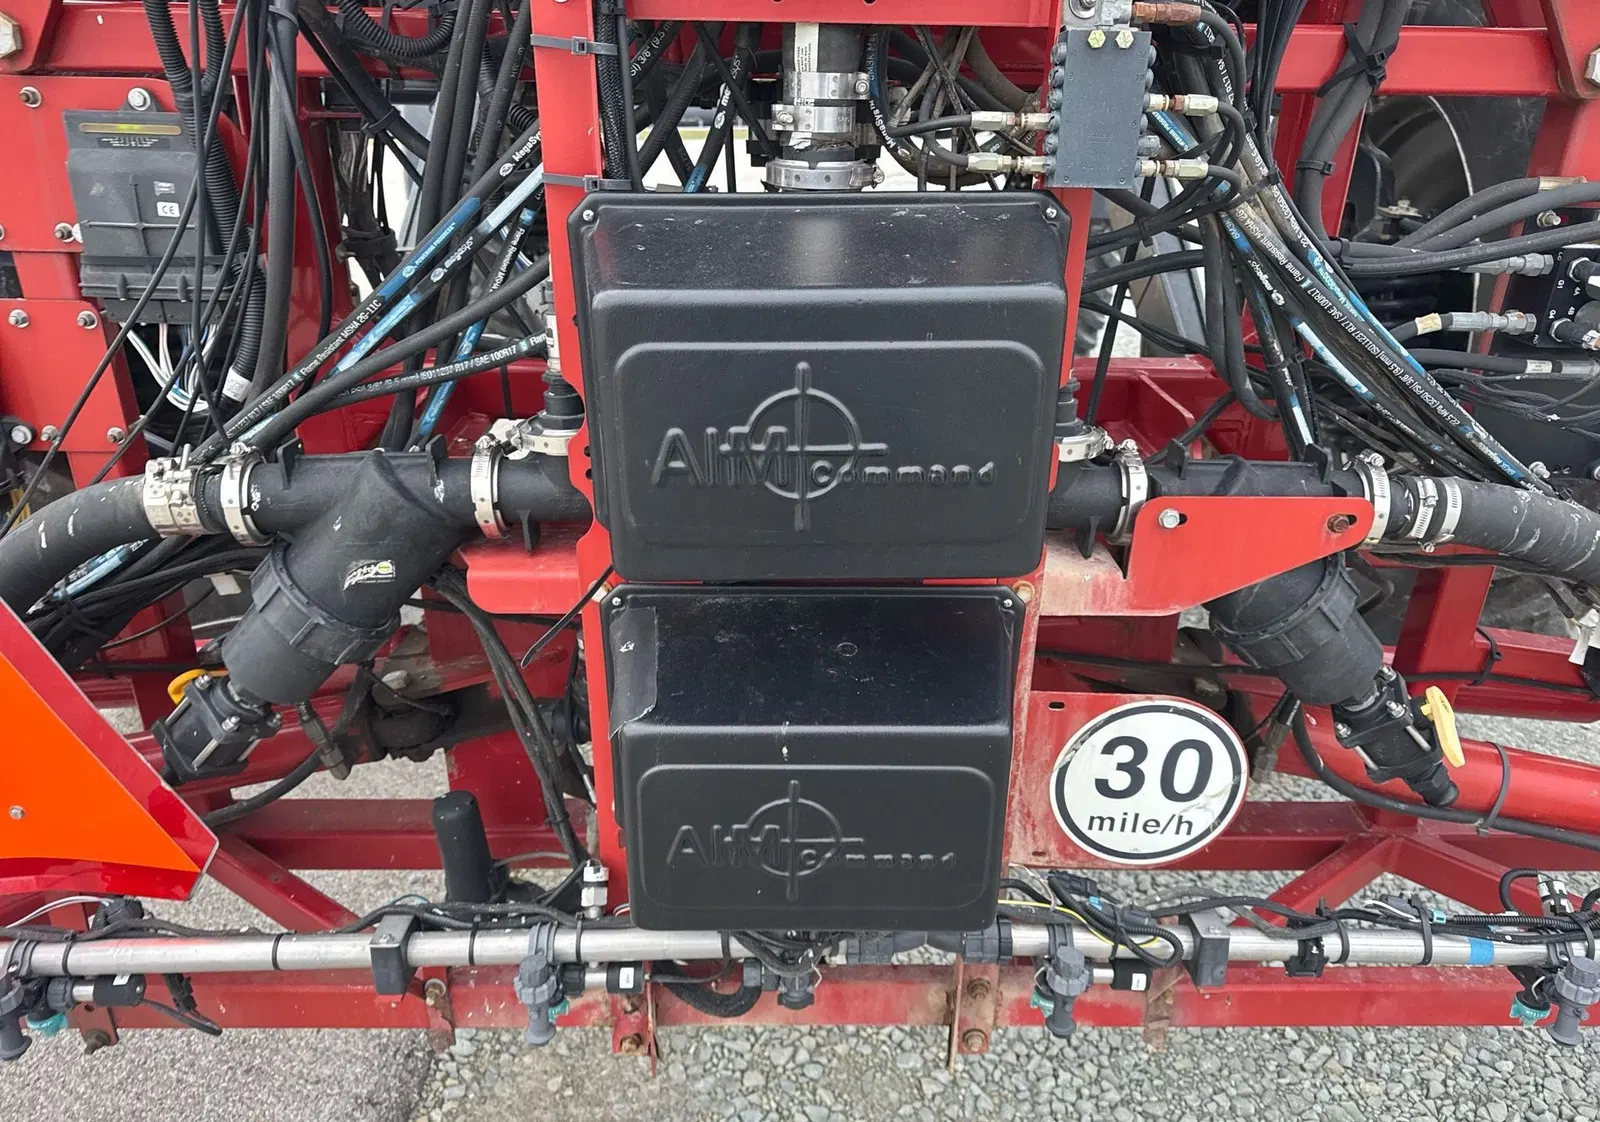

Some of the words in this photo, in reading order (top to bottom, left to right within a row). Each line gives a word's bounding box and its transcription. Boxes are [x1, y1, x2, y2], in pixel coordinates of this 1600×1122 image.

[648, 29, 668, 49] (9.5
[510, 226, 525, 247] Flame
[1243, 218, 1264, 239] MSHA
[498, 244, 517, 272] Resistant
[1259, 235, 1288, 265] Resistant
[490, 270, 505, 290] MSHA
[1283, 261, 1304, 282] Flame
[1306, 285, 1333, 310] 100R17
[1326, 304, 1343, 321] SAE
[1340, 318, 1357, 334] R17
[299, 356, 320, 377] Flame
[315, 334, 346, 362] Resistant
[340, 319, 361, 340] MSHA
[354, 297, 383, 324] 2G-11C
[1350, 327, 1381, 356] ISO11237
[454, 360, 469, 372] R17
[473, 353, 490, 367] SAE
[489, 344, 517, 361] 100R17
[1387, 360, 1404, 377] (9.5
[1419, 388, 1440, 409] (3250
[1433, 402, 1449, 418] MPa
[1444, 412, 1460, 428] 22.5
[650, 426, 791, 487] AIM
[809, 459, 997, 487] command
[1094, 735, 1214, 803] 30
[1087, 811, 1194, 836] mile/h
[666, 824, 781, 869] AIM
